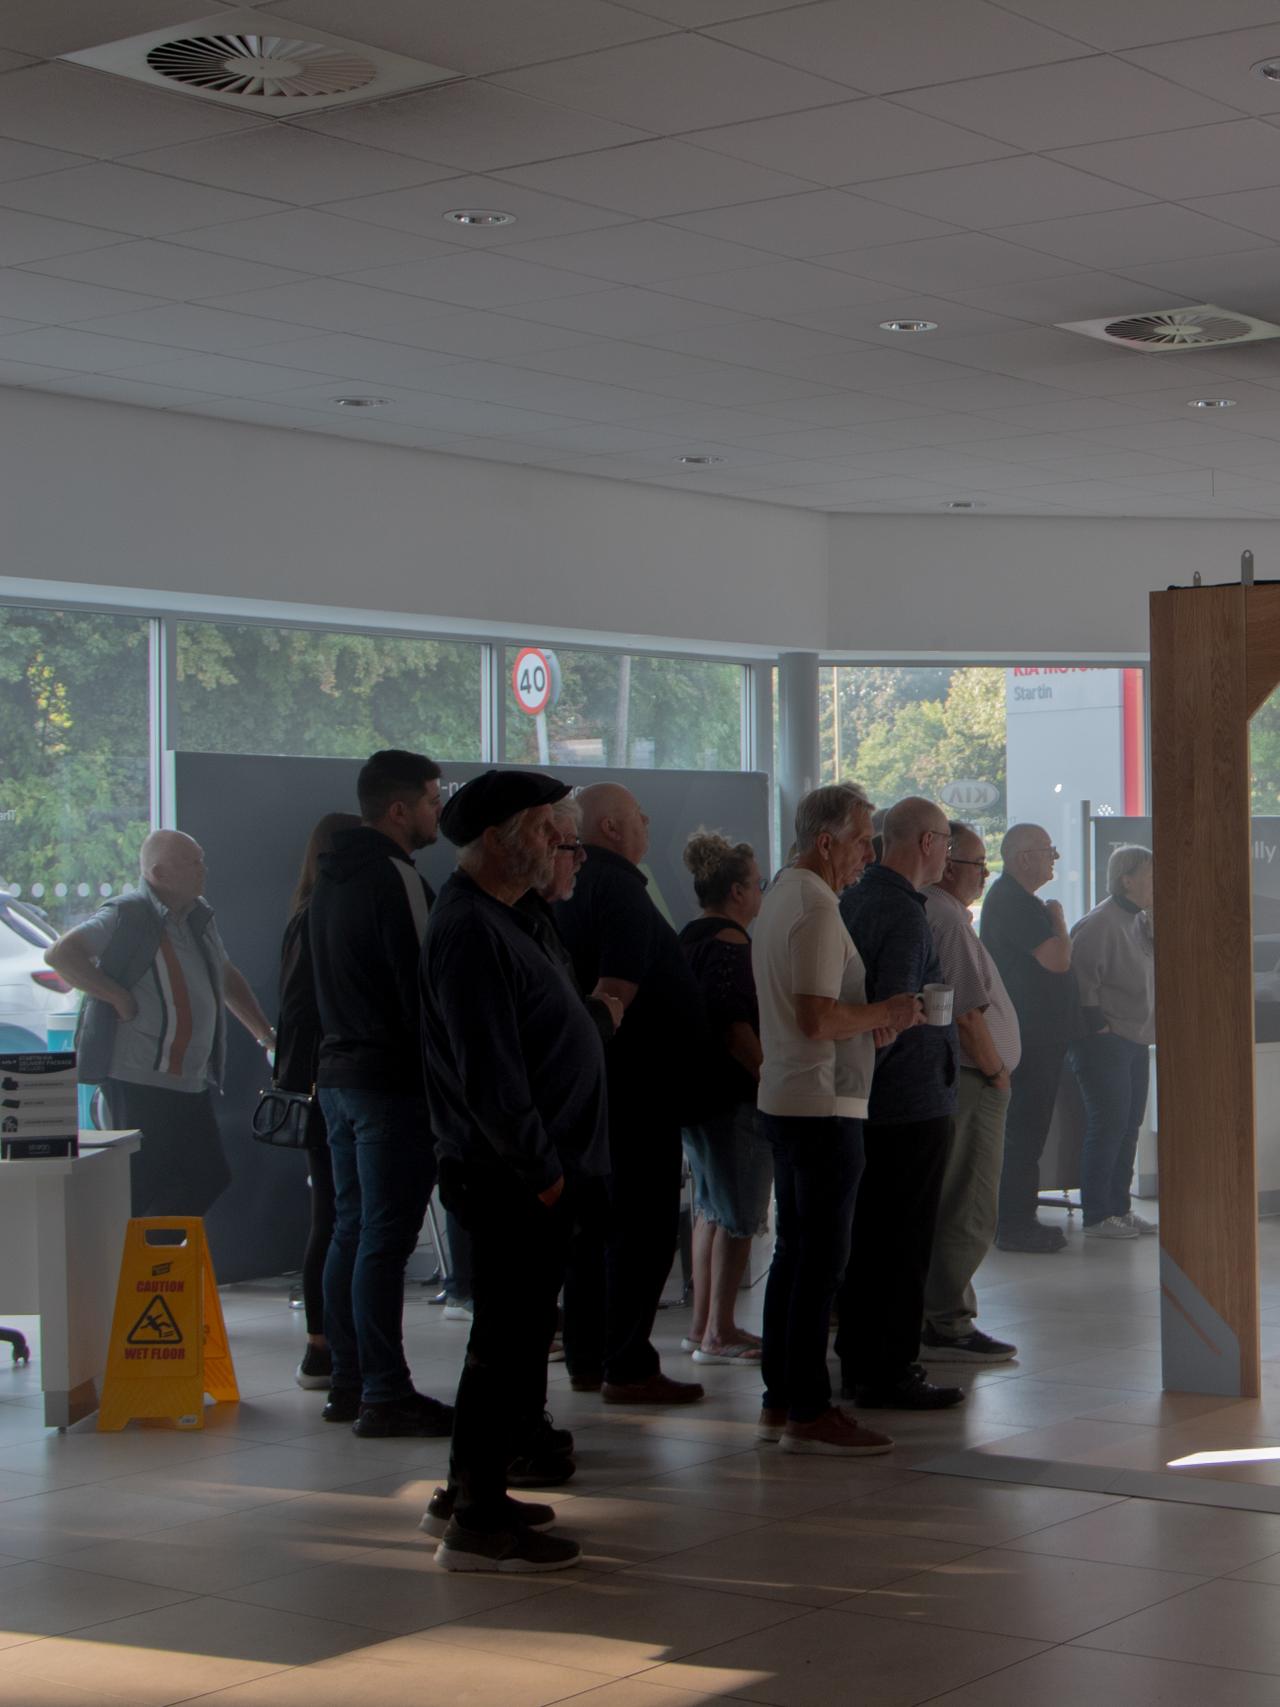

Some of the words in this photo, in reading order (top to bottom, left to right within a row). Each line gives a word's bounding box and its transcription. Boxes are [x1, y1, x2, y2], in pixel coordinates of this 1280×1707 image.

[520, 665, 546, 694] 40
[1014, 684, 1053, 701] Startin
[1252, 840, 1277, 863] lly
[136, 1280, 184, 1293] CAUTION
[125, 1347, 149, 1360] WET
[151, 1347, 185, 1360] FLOOR
